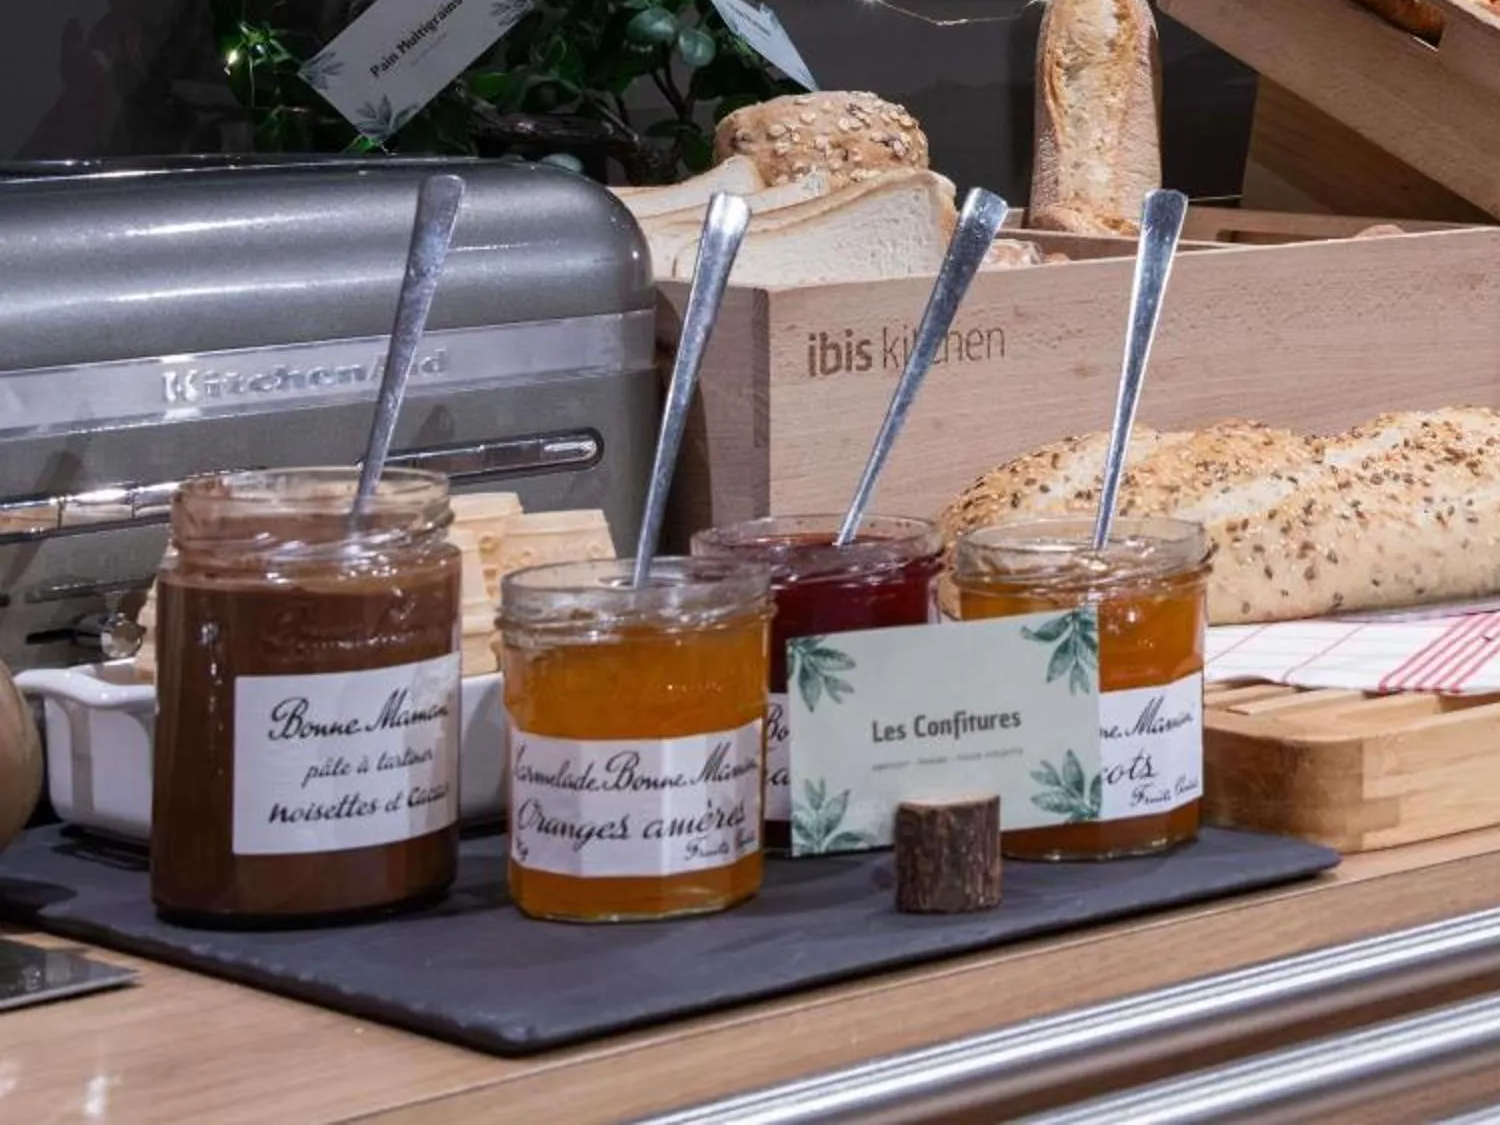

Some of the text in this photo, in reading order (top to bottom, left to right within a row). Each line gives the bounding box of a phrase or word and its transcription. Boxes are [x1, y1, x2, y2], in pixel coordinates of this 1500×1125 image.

[370, 53, 399, 78] Pain
[807, 324, 1006, 376] ibis kihen
[268, 696, 361, 741] Bonne
[871, 709, 1022, 743] Les Confitures
[301, 756, 351, 789] pâte
[356, 754, 369, 774] à
[600, 750, 689, 792] Bonne
[268, 792, 378, 824] noisettes
[384, 791, 403, 813] et
[517, 797, 630, 853] Oranges
[642, 798, 747, 840] amères
